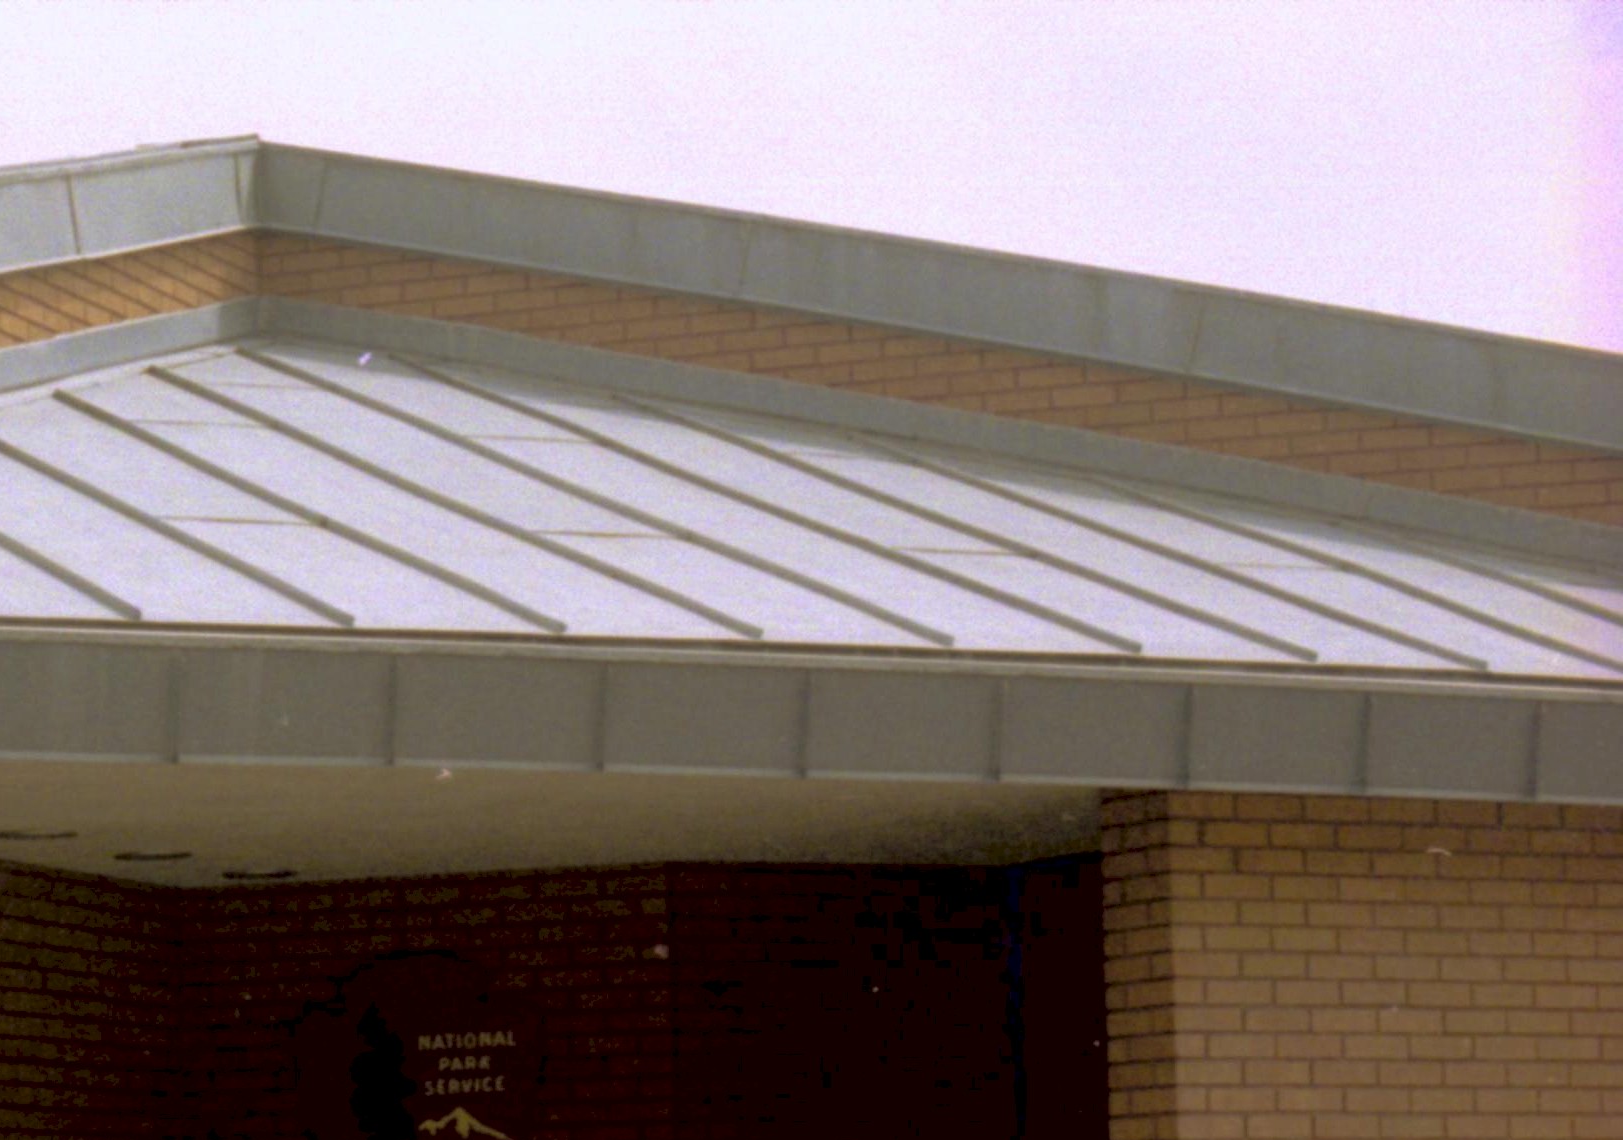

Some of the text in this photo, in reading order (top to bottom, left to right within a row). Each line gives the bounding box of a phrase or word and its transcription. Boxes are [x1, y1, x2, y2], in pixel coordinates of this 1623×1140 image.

[418, 1031, 517, 1052] NATIONAL
[438, 1055, 492, 1071] PARK
[424, 1075, 506, 1096] SERVICE
